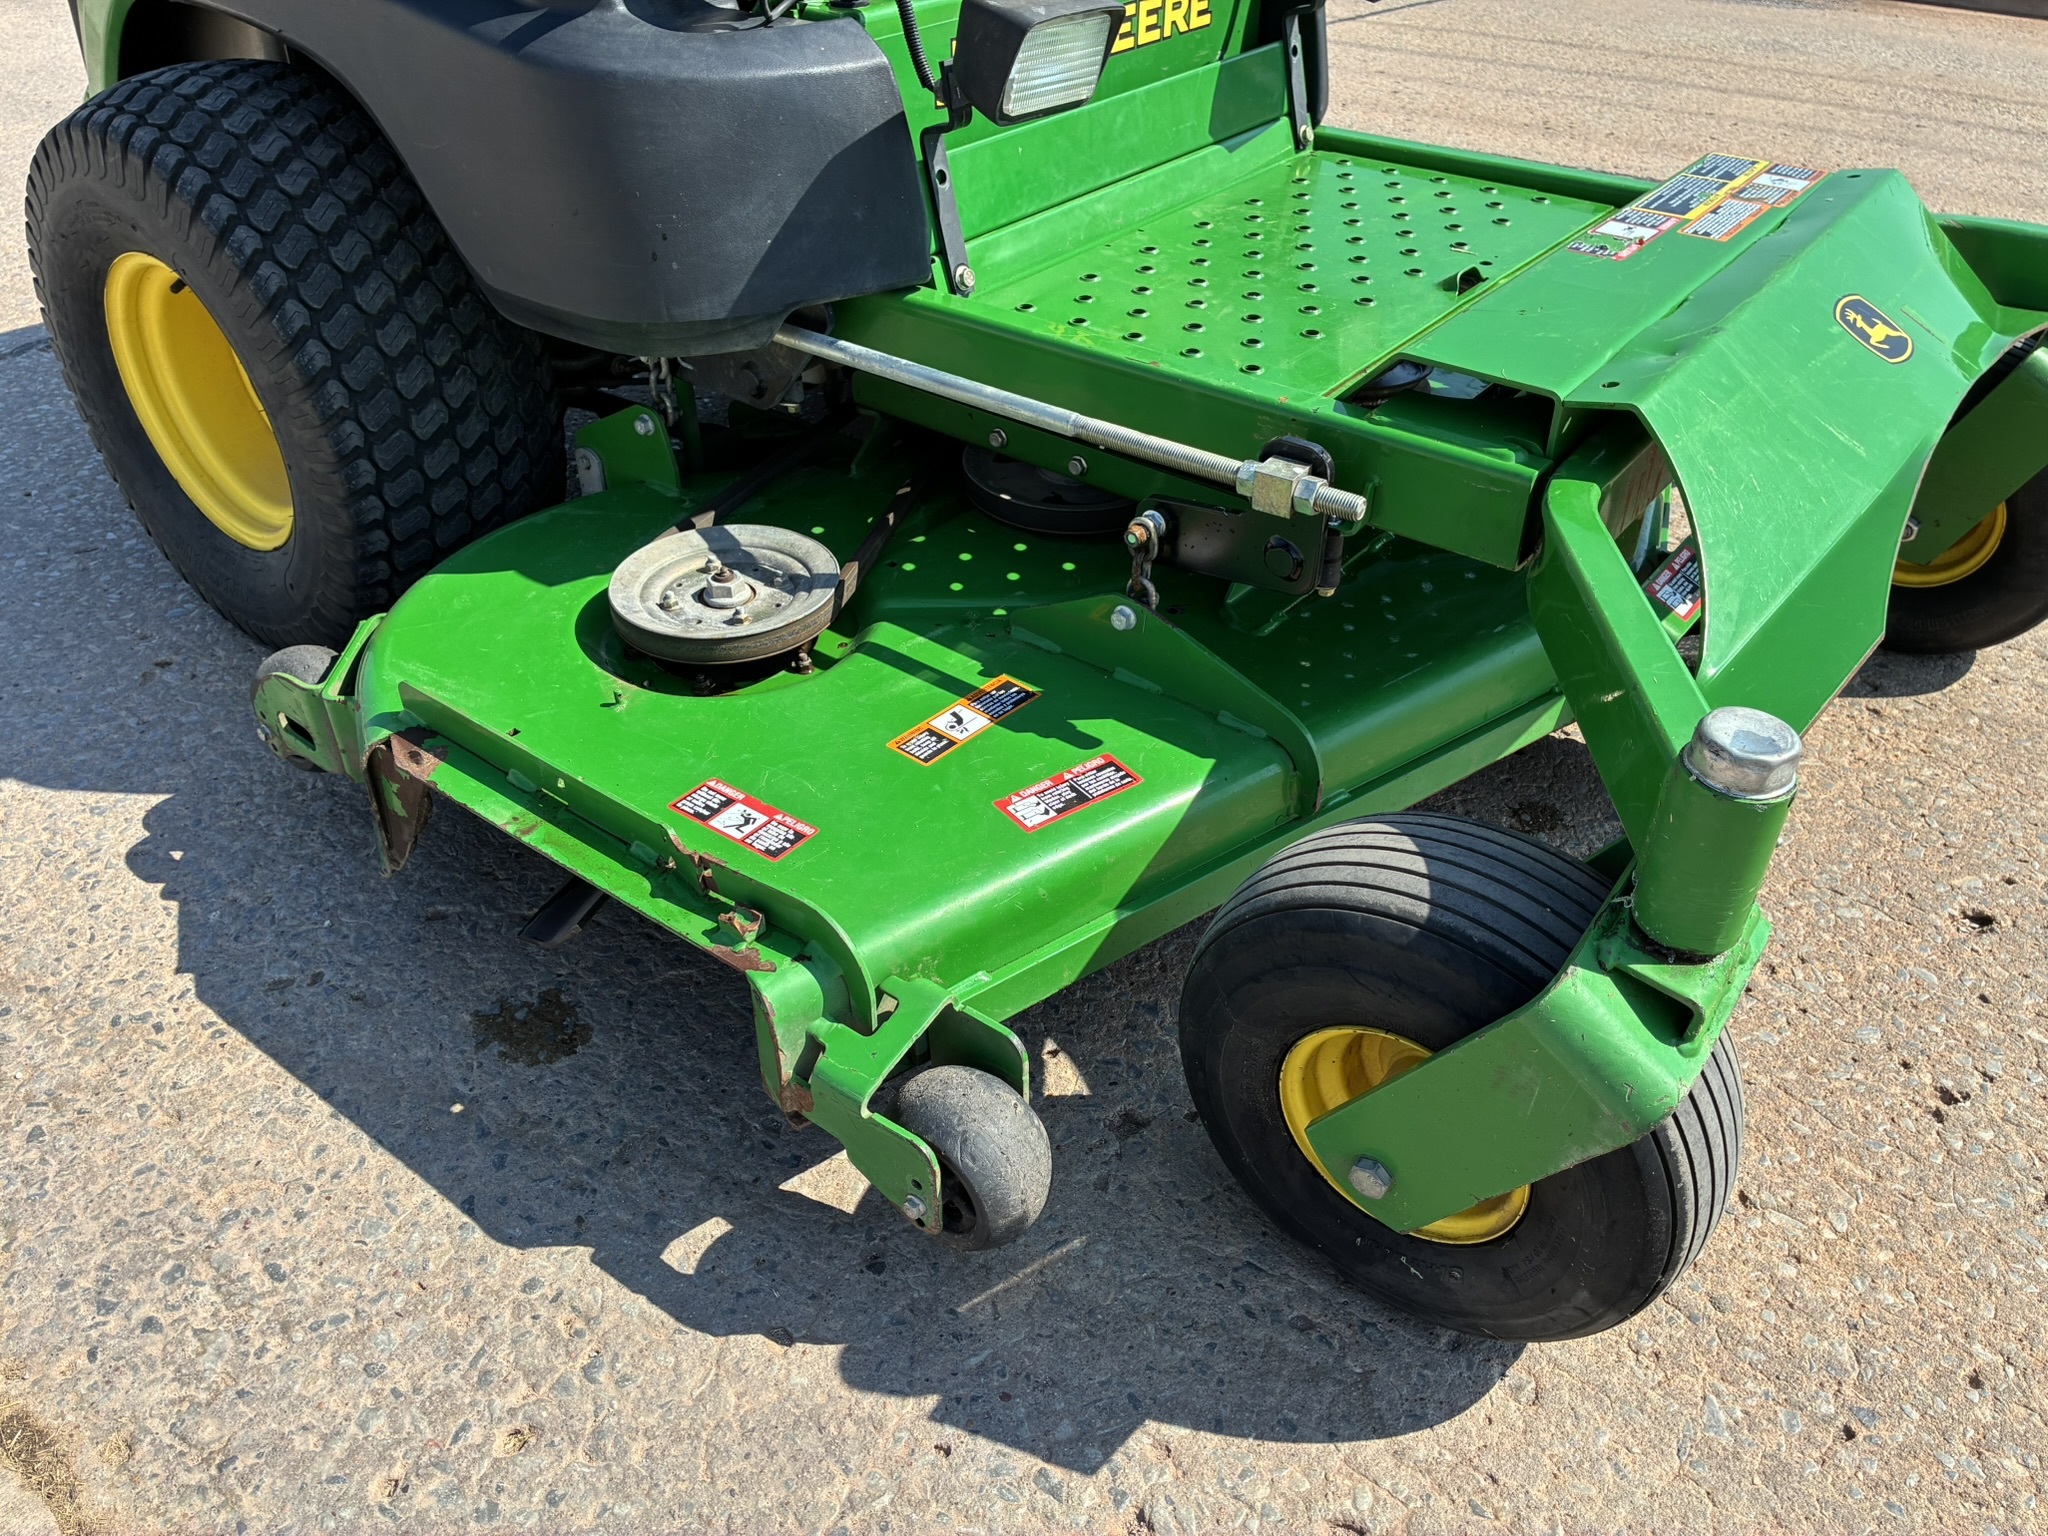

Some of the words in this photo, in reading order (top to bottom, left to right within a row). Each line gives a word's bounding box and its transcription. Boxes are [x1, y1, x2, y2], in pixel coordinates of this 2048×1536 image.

[1110, 0, 1212, 54] EERE
[1019, 779, 1054, 798] DANGER
[1071, 757, 1105, 775] PELIGRO
[714, 781, 746, 800] DANGER
[781, 815, 816, 835] PELIGRO
